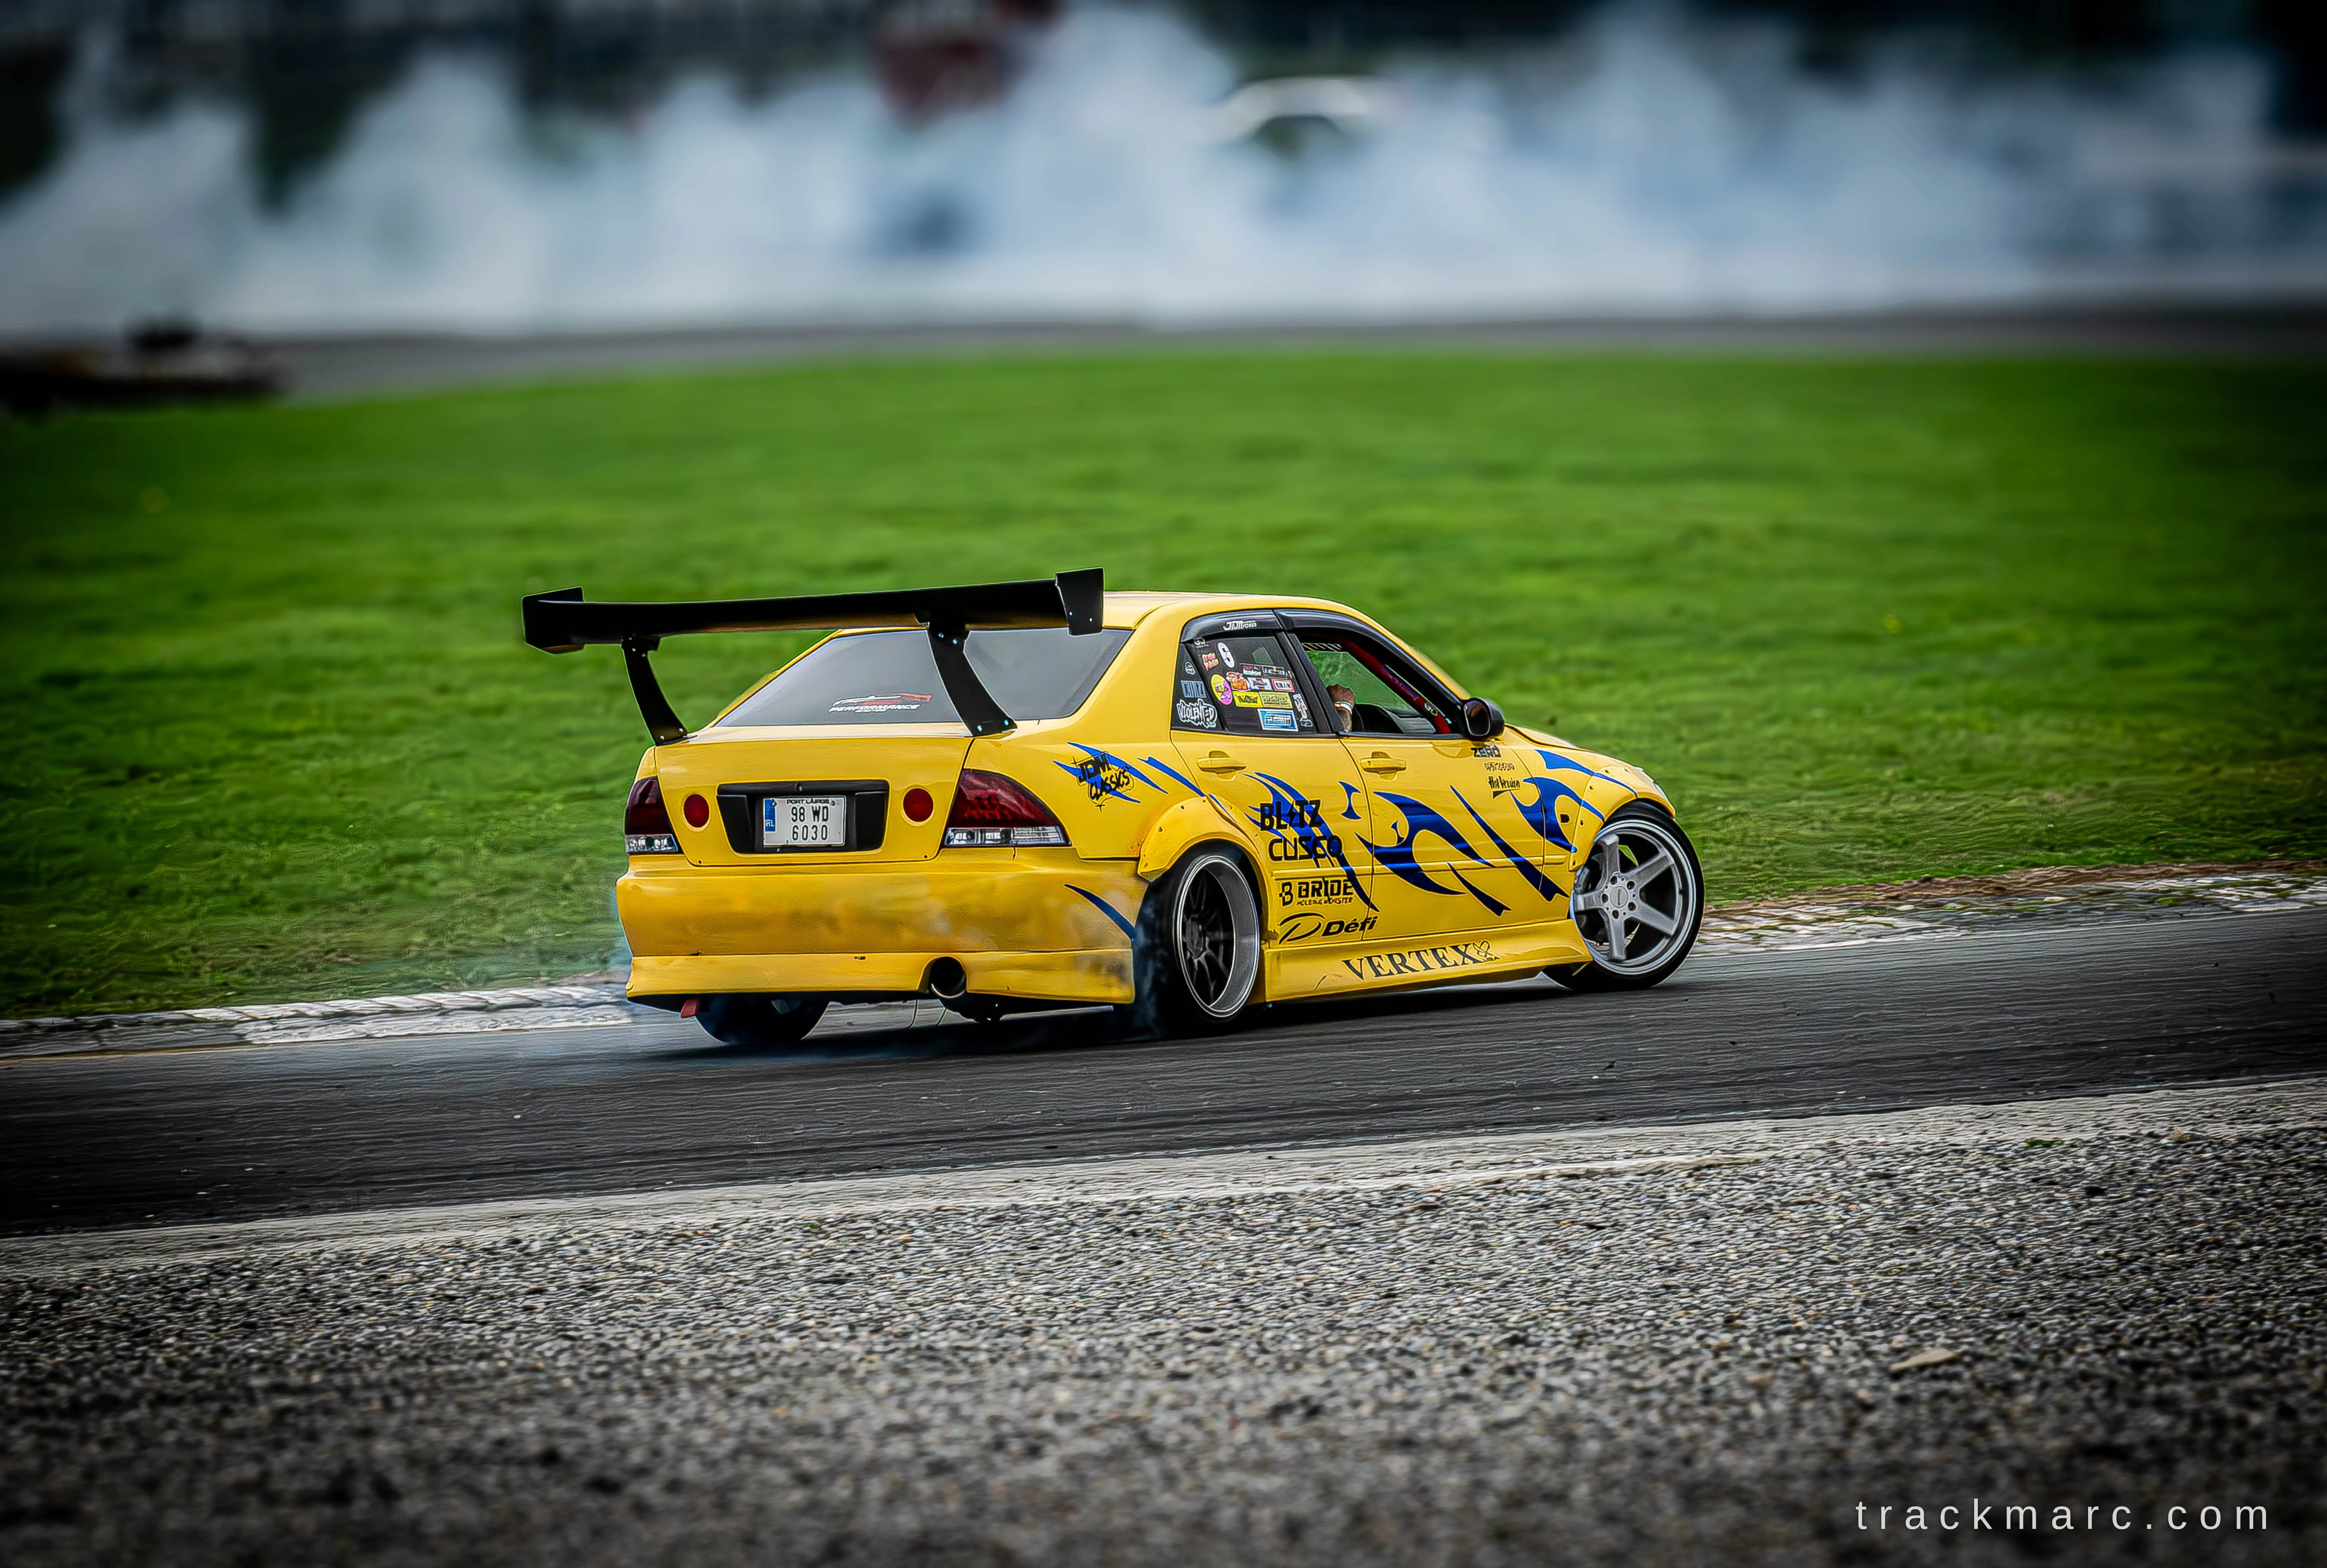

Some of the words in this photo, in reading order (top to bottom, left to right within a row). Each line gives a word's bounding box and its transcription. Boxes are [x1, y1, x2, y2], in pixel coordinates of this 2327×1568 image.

[1471, 745, 1502, 758] ZERO
[1078, 754, 1112, 784] JDM
[1089, 768, 1130, 801] CLASSICS
[791, 806, 806, 822] 98
[811, 806, 829, 822] WD
[1260, 799, 1321, 831] BLITZ
[792, 824, 828, 841] 6030
[1268, 835, 1343, 861] CUSCO
[1297, 879, 1354, 899] BRIDE
[1341, 943, 1484, 980] VERTEX
